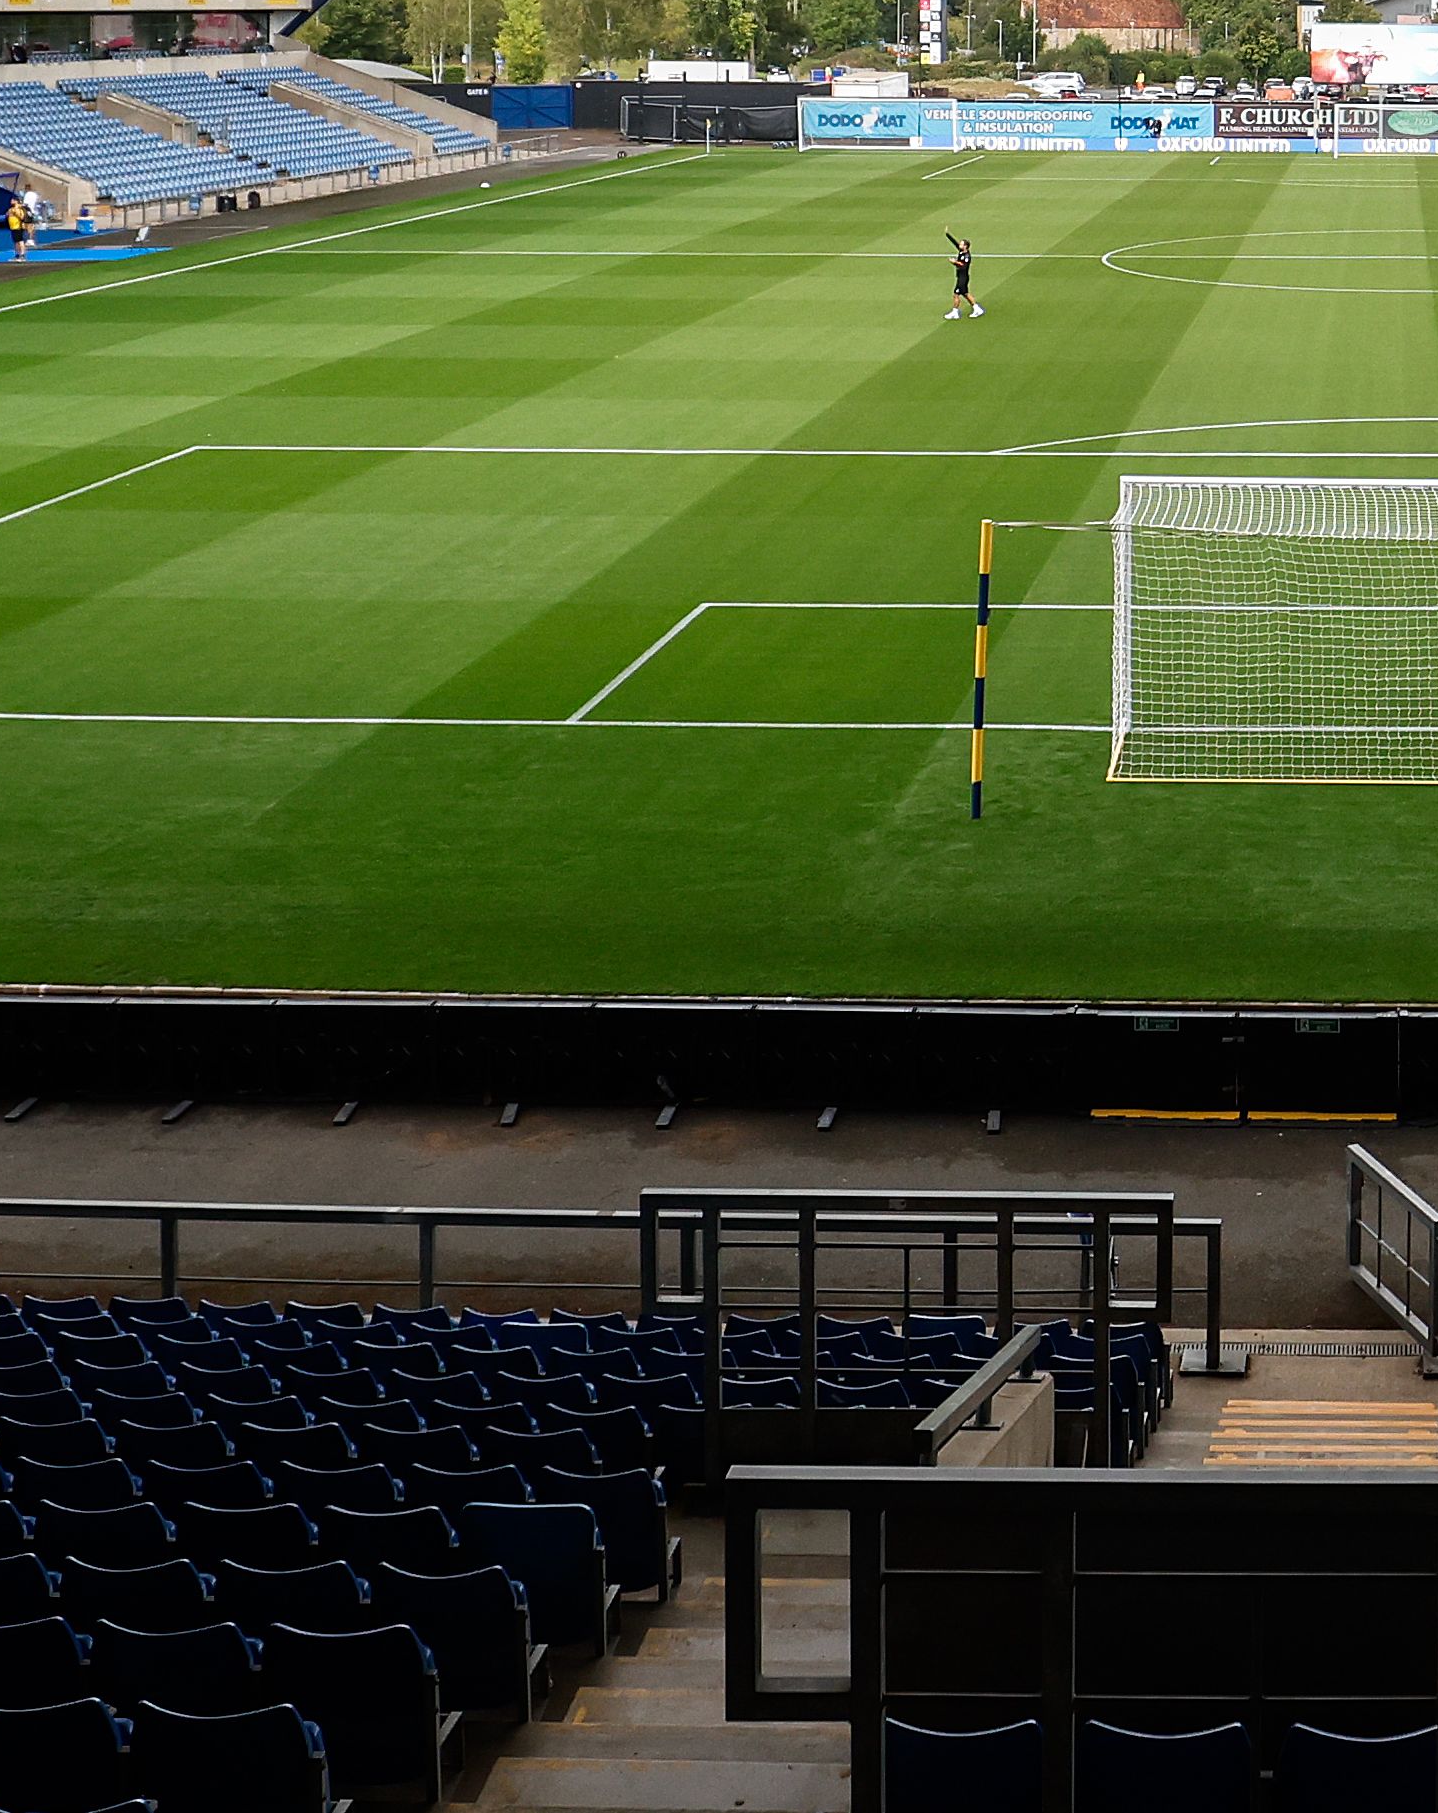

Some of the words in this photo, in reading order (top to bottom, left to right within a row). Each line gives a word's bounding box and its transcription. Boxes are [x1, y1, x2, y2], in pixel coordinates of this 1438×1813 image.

[817, 114, 863, 128] DODO
[874, 114, 907, 128] MAT
[924, 109, 976, 121] VEHICLE
[977, 110, 1094, 121] SOUNDPROOFING
[1220, 108, 1236, 125] F.
[1240, 108, 1333, 126] CHURCH
[1338, 109, 1379, 127] LTD
[962, 122, 972, 133] &
[975, 122, 1054, 134] INSULATION
[1167, 117, 1200, 130] MAT
[1157, 137, 1225, 152] OXFORD
[1362, 139, 1431, 153] OXFORD
